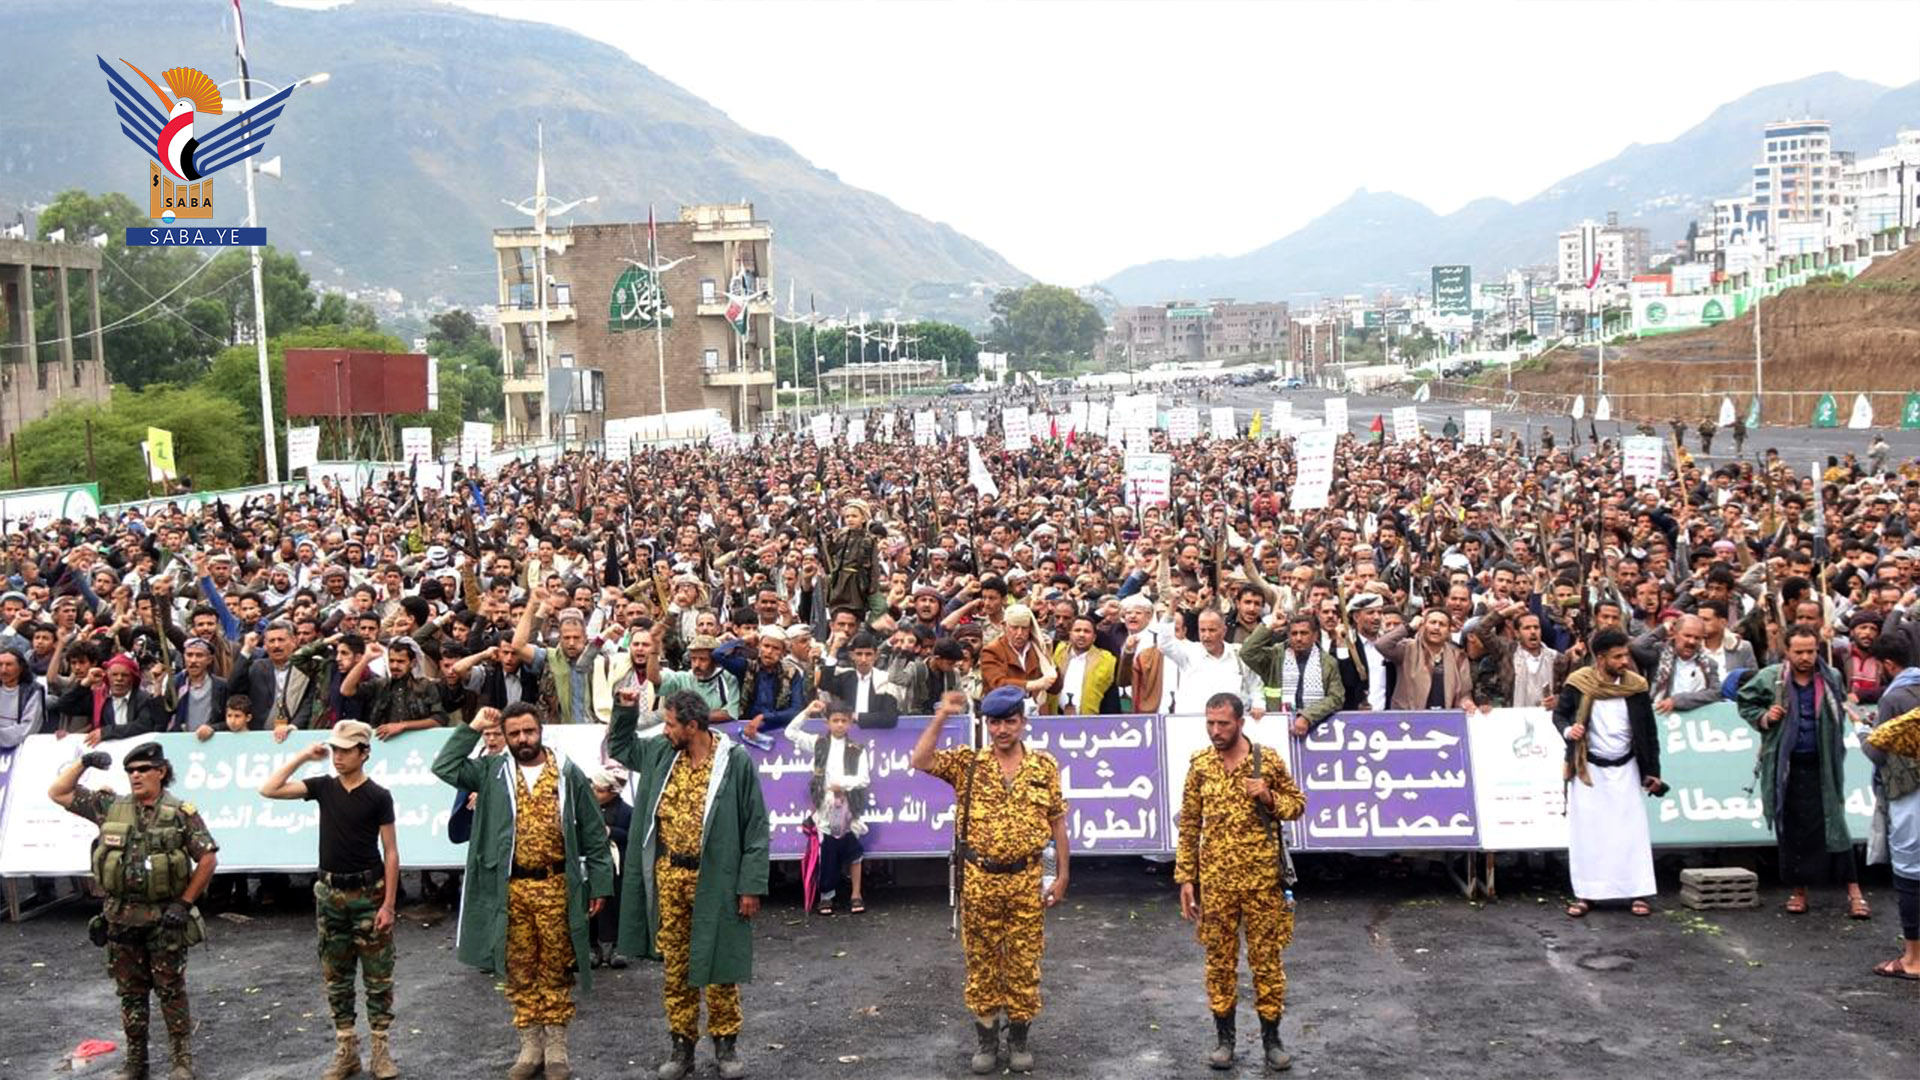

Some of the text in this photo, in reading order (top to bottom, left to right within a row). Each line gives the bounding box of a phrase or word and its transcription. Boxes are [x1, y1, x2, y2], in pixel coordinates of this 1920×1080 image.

[1058, 718, 1153, 759] اضرب
[1305, 718, 1460, 761] جنودك
[1305, 756, 1467, 800] سيوفك
[1066, 807, 1157, 849] الطوا
[1309, 801, 1475, 838] عصائك
